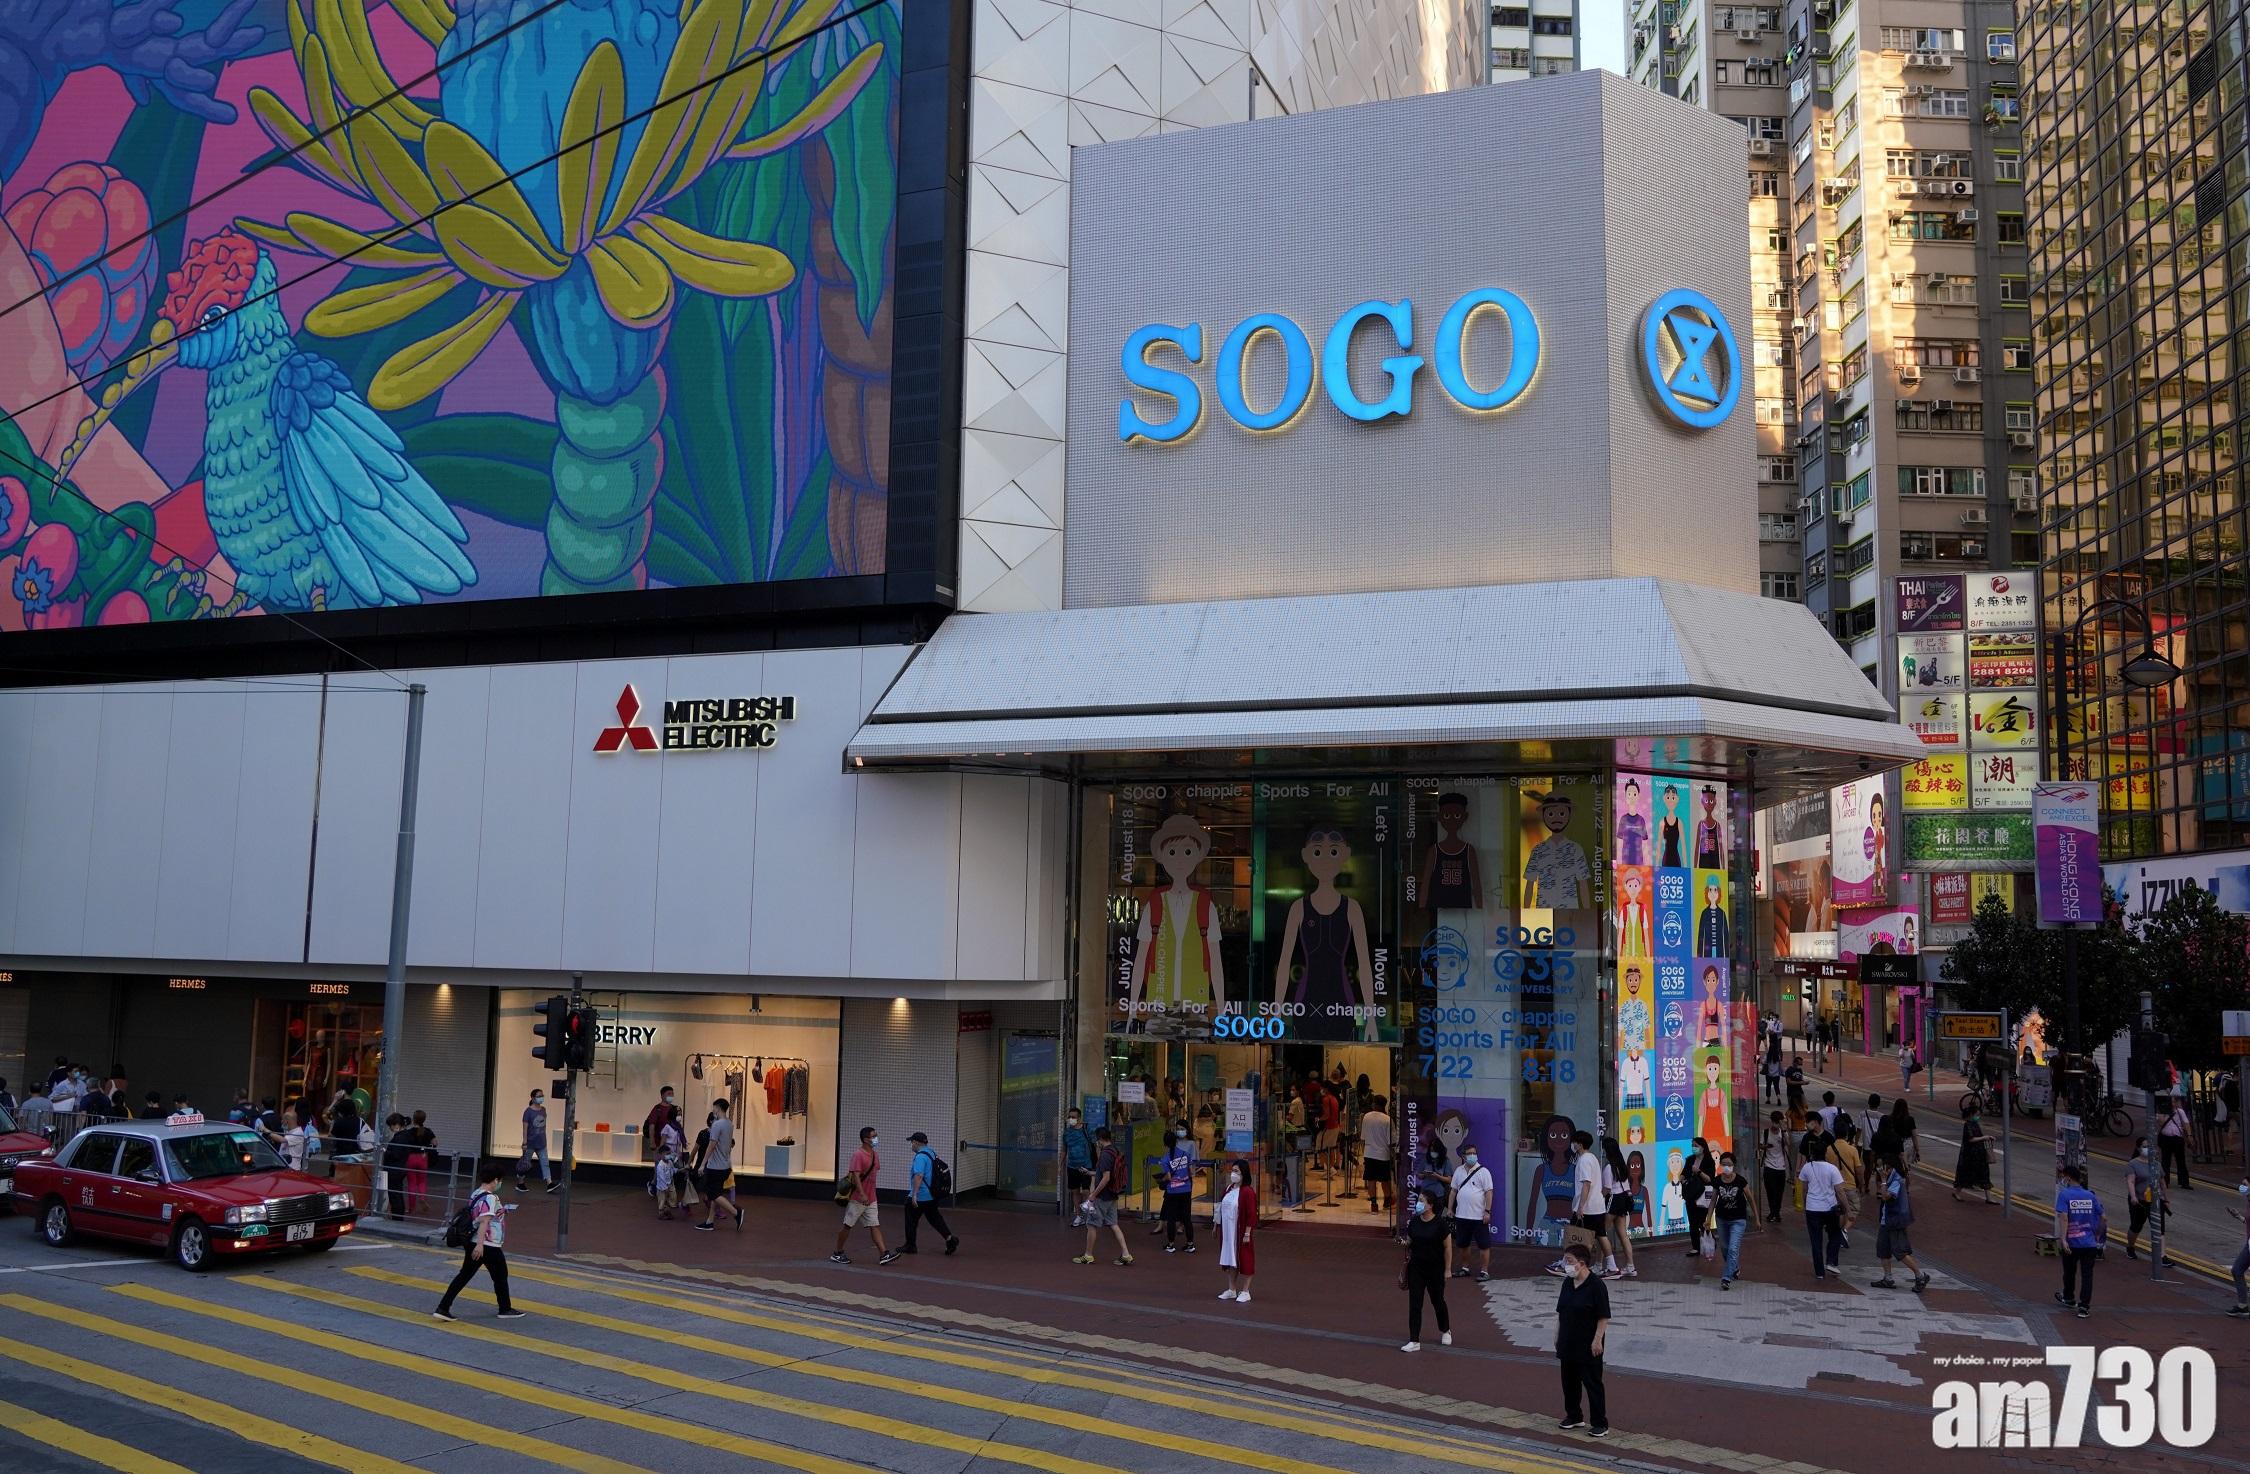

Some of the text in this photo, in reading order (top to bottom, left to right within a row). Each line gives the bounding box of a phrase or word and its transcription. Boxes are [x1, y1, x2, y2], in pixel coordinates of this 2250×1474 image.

[1119, 287, 1541, 442] SOGO
[1899, 581, 1925, 596] THAI
[1902, 610, 1916, 620] 8/F
[2004, 667, 2033, 675] 8204
[1943, 675, 1960, 685] 5/F
[663, 696, 795, 724] MITSUBISHI
[1995, 695, 2033, 733] 金
[663, 724, 776, 749] ELECTRIC
[2020, 737, 2036, 746] 6/F
[1914, 760, 1954, 777] 傷心
[1982, 754, 2016, 785] 潮
[1406, 776, 1496, 788] SOGO chappie
[1509, 775, 1604, 788] Sports For All
[1905, 777, 1964, 794] 酸辣粉
[1122, 786, 1167, 800] SOGO
[1186, 783, 1243, 800] chappie
[1260, 782, 1389, 800] Sports For All
[1593, 788, 1604, 830] July 22
[1950, 796, 1965, 806] 5/F
[1974, 797, 1991, 806] 5/F
[1122, 809, 1134, 829] 18
[1375, 805, 1388, 842] Let's
[1406, 792, 1416, 839] Summer
[2064, 814, 2095, 822] EXCEL
[1935, 827, 2010, 845] 花園餐廳
[1121, 830, 1136, 883] August
[1592, 844, 1604, 903] August 18
[1660, 875, 1684, 885] SOGO
[2058, 833, 2070, 919] ASIA'S WORLD CITY
[2066, 832, 2081, 919] HONG KONG
[1406, 875, 1416, 902] 2020
[1669, 886, 1684, 900] 35
[1436, 933, 1454, 942] CHP
[1495, 926, 1577, 947] SOGO
[1119, 936, 1132, 955] 22
[1118, 958, 1134, 990] July
[1374, 948, 1388, 996] Move!
[1526, 950, 1576, 982] 35
[1661, 966, 1685, 975] SOGO
[169, 979, 206, 990] HERMÈS
[310, 983, 349, 995] HERMÈS
[1494, 984, 1575, 995] ANNIVERSARY
[1670, 976, 1685, 990] 35
[1118, 997, 1242, 1017] Sports For All
[1258, 1001, 1306, 1017] SOGO
[1326, 1002, 1387, 1020] chappie
[1418, 1007, 1476, 1025] SOGO
[1501, 1008, 1576, 1029] chappie
[594, 1025, 657, 1045] BERRY
[1213, 1015, 1286, 1039] SOGO
[1417, 1026, 1576, 1051] Sports For All
[1417, 1053, 1577, 1084] 7.22 8.18
[1662, 1057, 1686, 1067] SOGO
[1671, 1066, 1687, 1081] 35
[172, 1114, 202, 1124] TAXI
[1232, 1113, 1246, 1121] 入口
[1232, 1120, 1247, 1128] Entry
[1596, 1108, 1607, 1137] Let's
[1407, 1101, 1420, 1215] July 22 August 18
[82, 1195, 94, 1206] TAXI
[293, 1231, 309, 1241] 817
[296, 1224, 307, 1233] TG
[1510, 1225, 1549, 1240] Sports
[1571, 1234, 1583, 1242] GU
